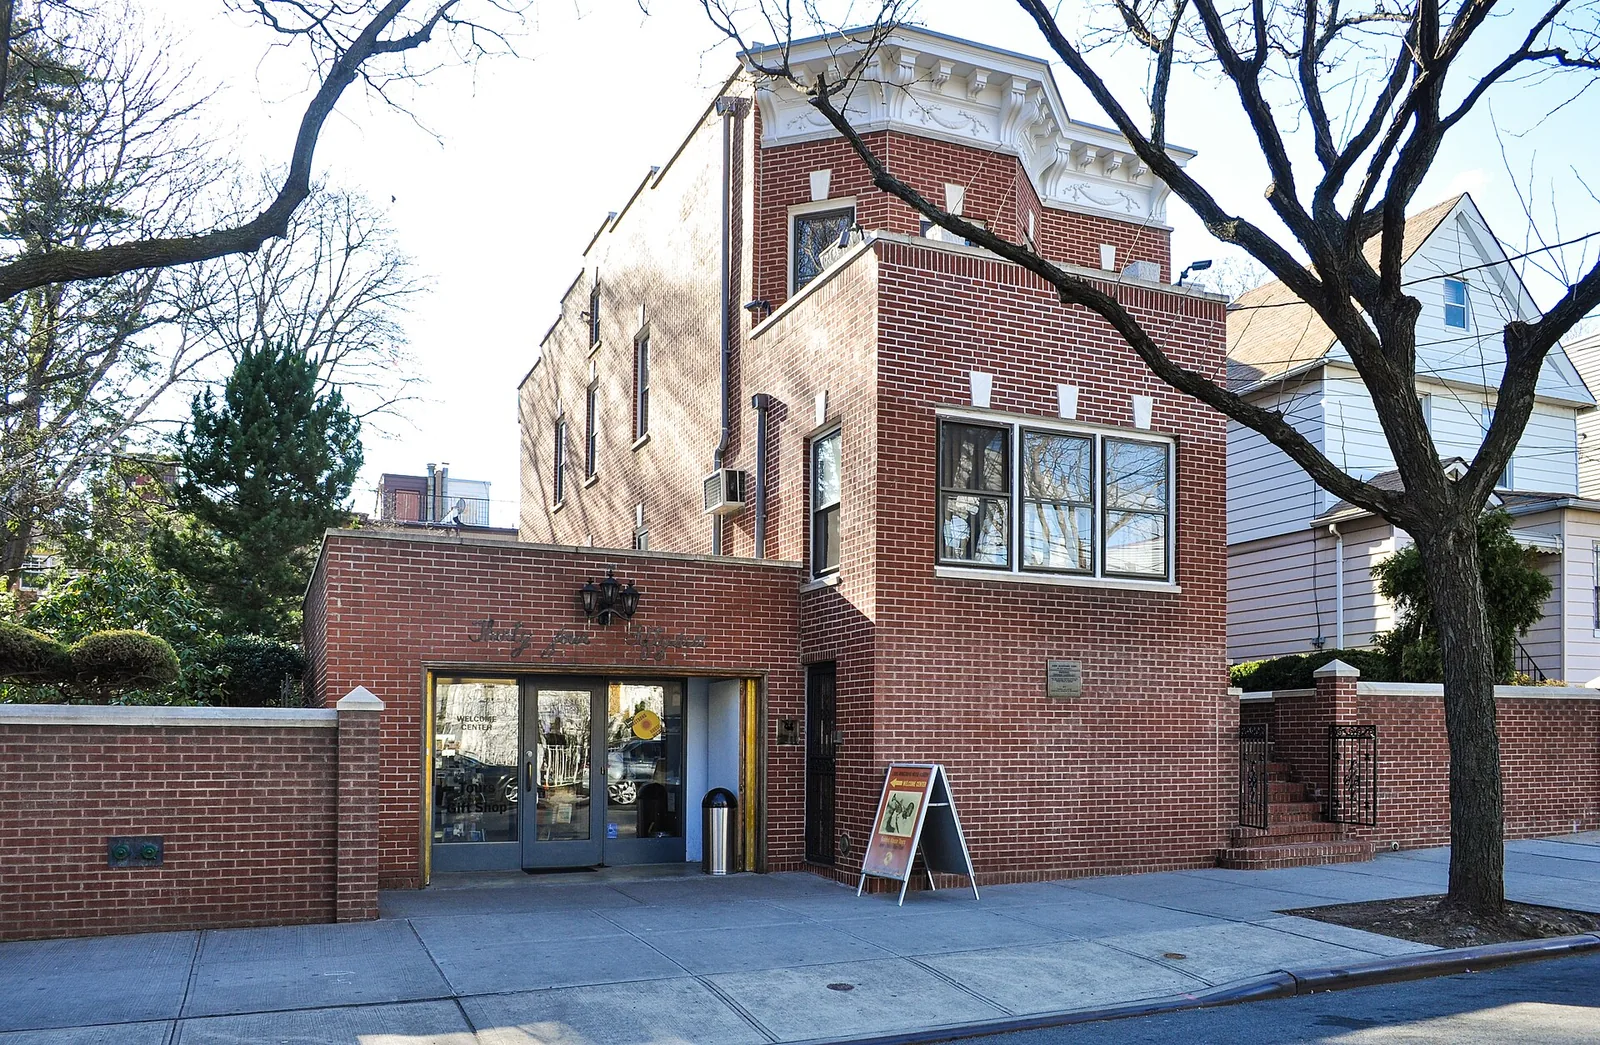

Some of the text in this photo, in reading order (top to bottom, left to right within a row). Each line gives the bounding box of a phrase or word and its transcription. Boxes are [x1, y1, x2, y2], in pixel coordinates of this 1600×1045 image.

[456, 715, 497, 724] WELCOME
[459, 783, 496, 794] Tours
[447, 801, 507, 815] Gift Shop
